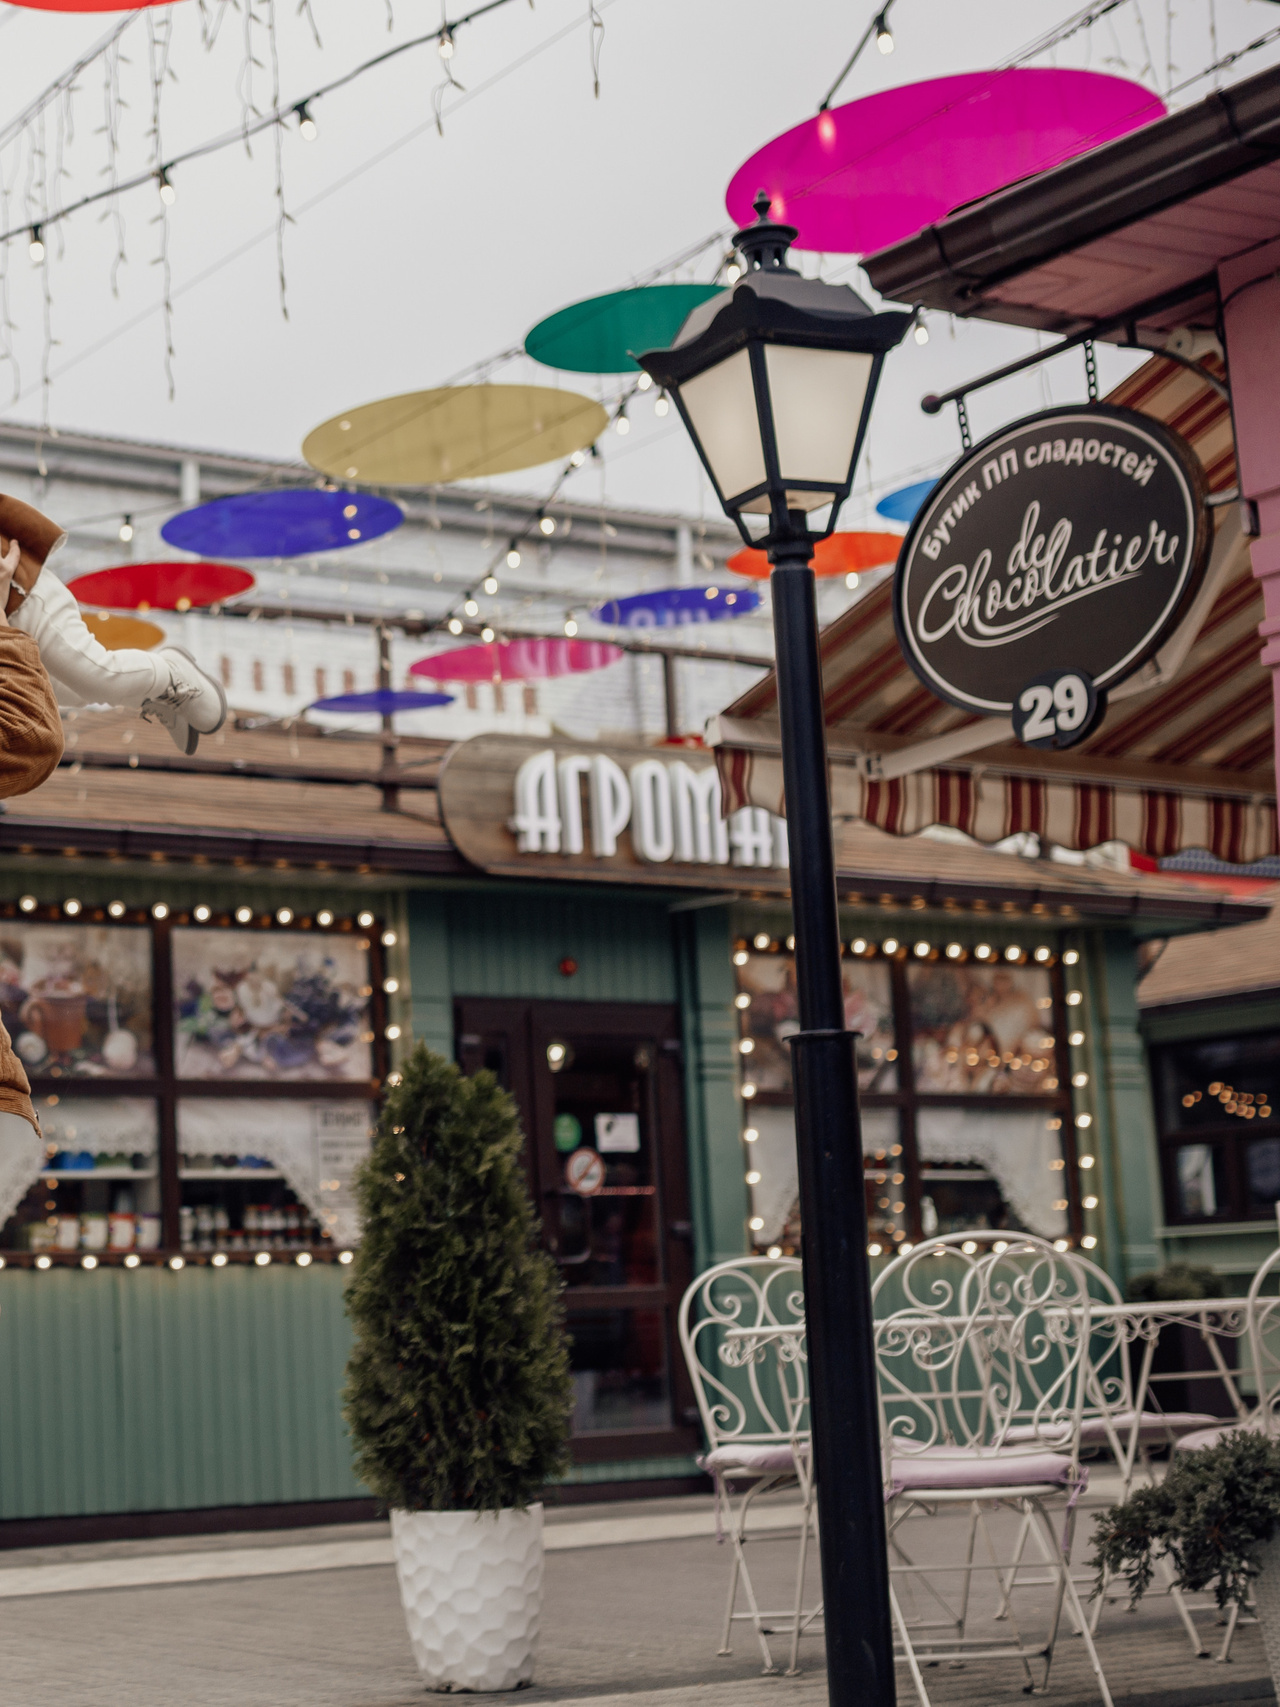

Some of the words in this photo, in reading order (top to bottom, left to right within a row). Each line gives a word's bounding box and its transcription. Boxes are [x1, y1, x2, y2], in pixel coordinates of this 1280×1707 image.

[922, 480, 981, 561] Бутик
[982, 448, 1019, 490] ПП
[1024, 437, 1158, 487] сладостей
[918, 518, 1180, 643] Chocolatier
[1019, 674, 1090, 742] 29
